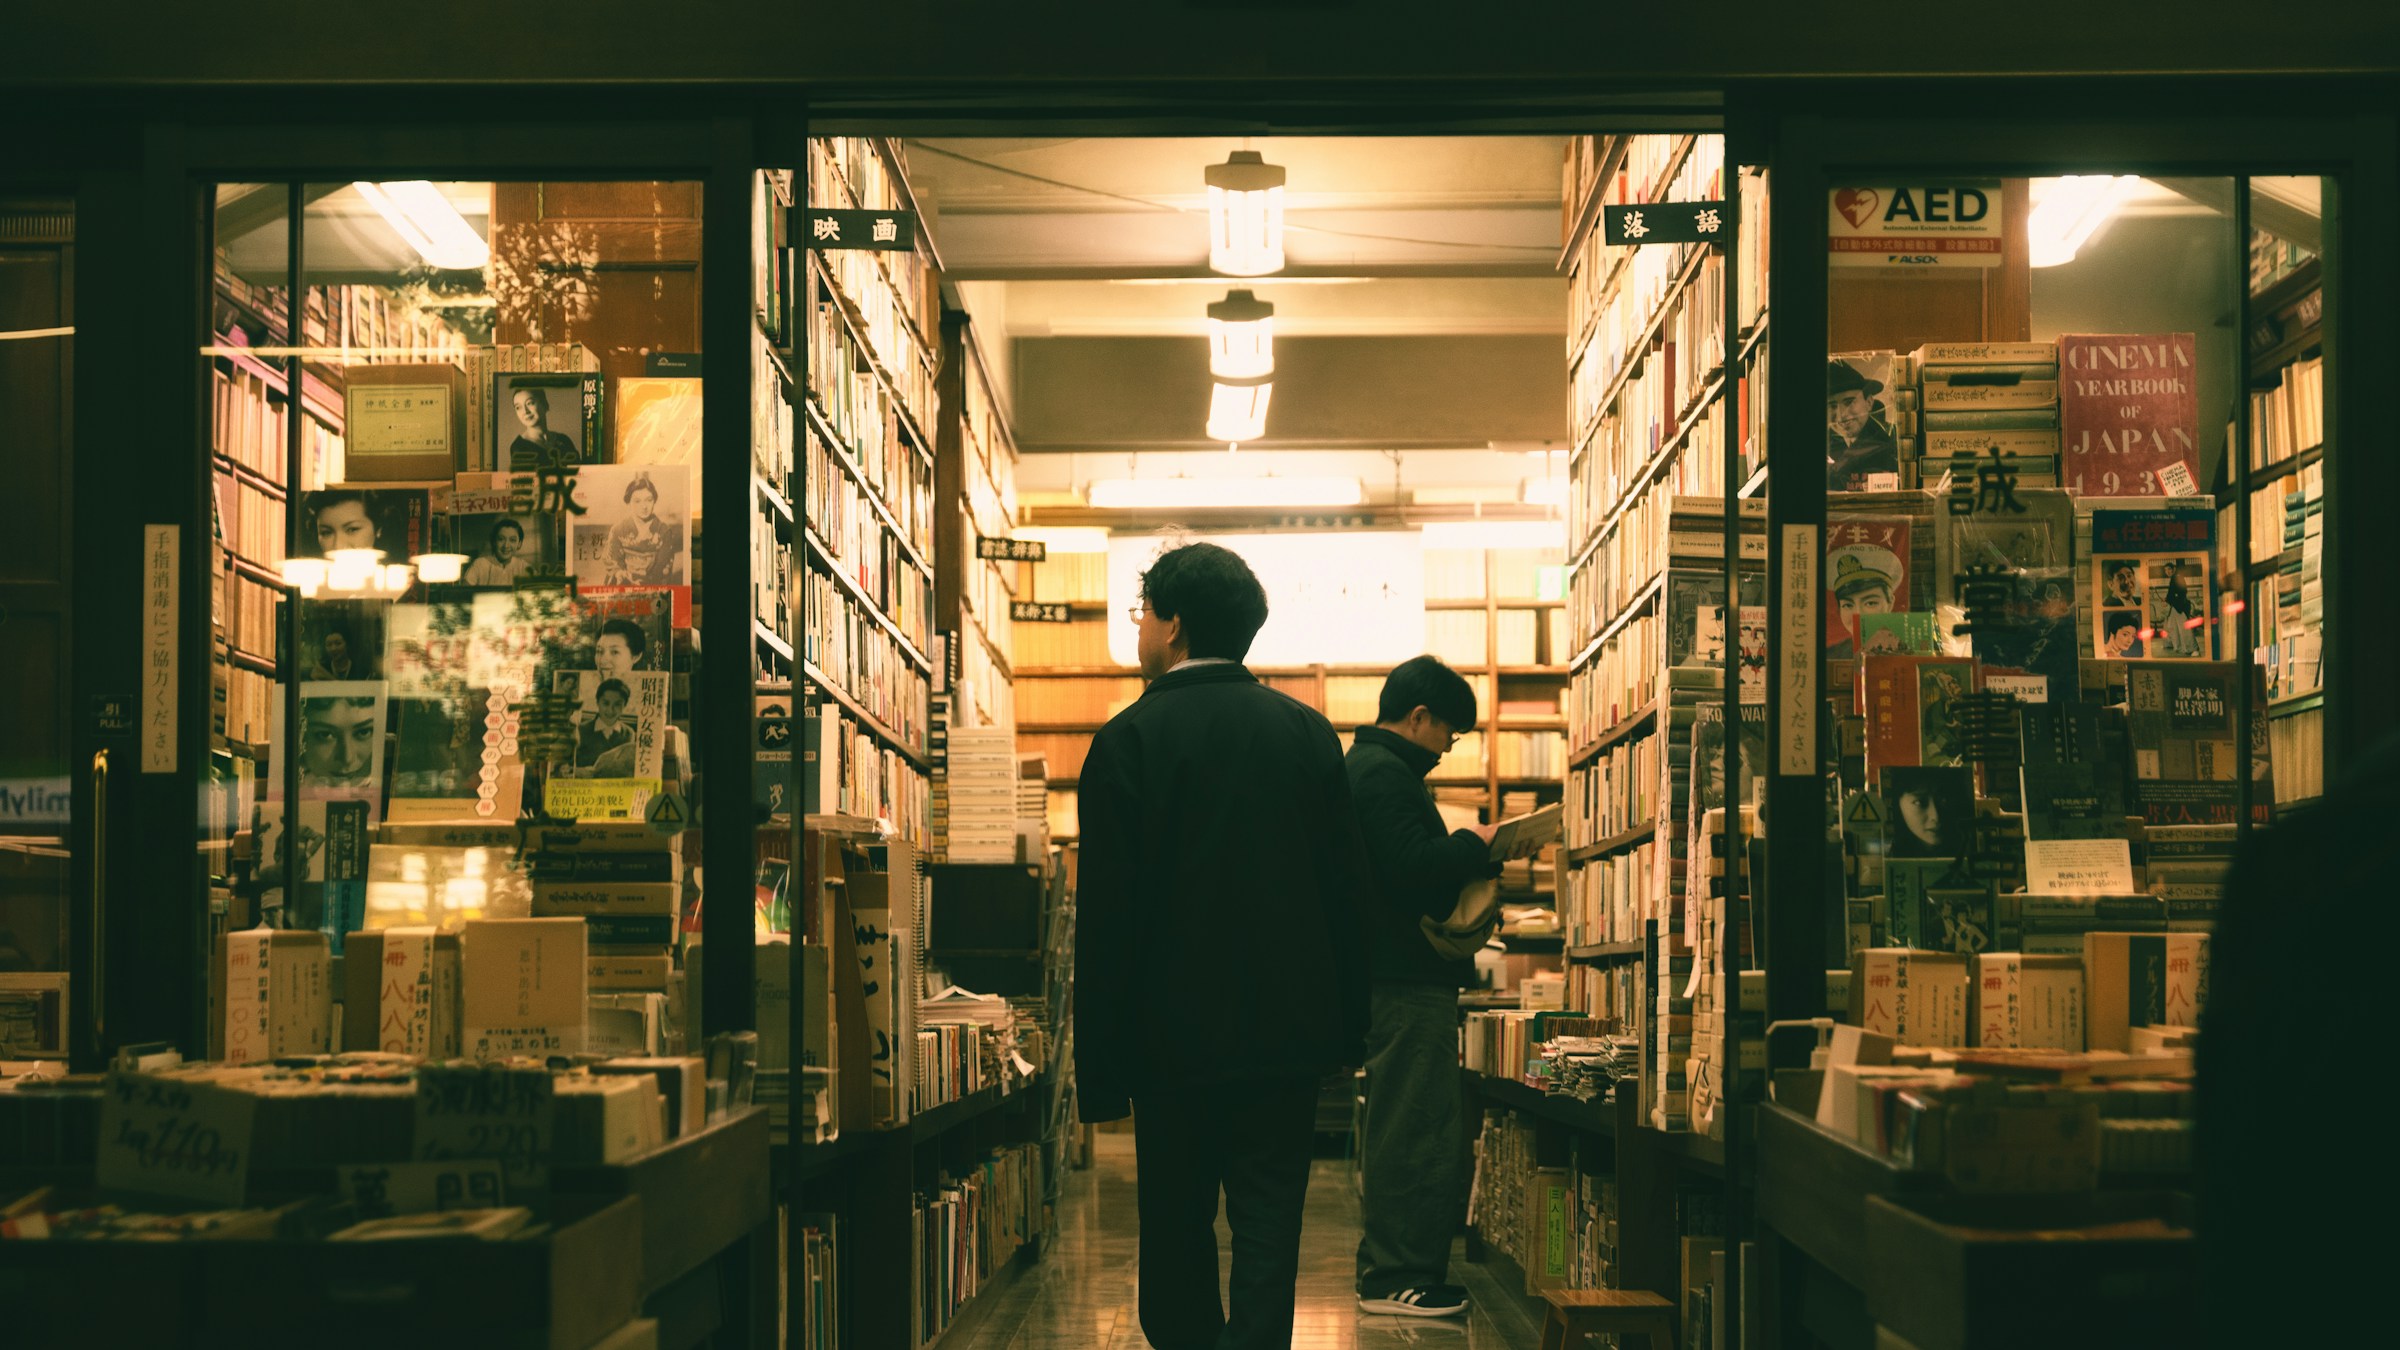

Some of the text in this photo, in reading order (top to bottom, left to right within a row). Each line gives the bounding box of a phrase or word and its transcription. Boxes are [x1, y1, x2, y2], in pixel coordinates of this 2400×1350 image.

[1884, 188, 1988, 222] AED
[813, 217, 897, 242] 映画
[1623, 209, 1722, 239] 落語
[1900, 255, 1938, 264] ALSOK
[2068, 344, 2189, 370] CINEMA
[584, 379, 597, 419] 原節子
[2073, 378, 2187, 397] YEARBOOK
[2119, 405, 2142, 419] OF
[2072, 427, 2193, 455] JAPAN
[2073, 470, 2156, 494] 193
[152, 530, 170, 767] 手指消毒にご協力ください
[1790, 531, 1810, 768] 手指消毒にご協力ください
[2177, 687, 2219, 699] 脚本家
[104, 702, 119, 715] 引
[2174, 699, 2224, 717] 黒澤明
[98, 717, 122, 727] PULL
[639, 677, 657, 776] 昭和の女優たち
[1867, 964, 1892, 1032] 一冊八
[1983, 968, 2004, 1048] 一冊一、六
[1551, 1189, 1560, 1213] 三人
